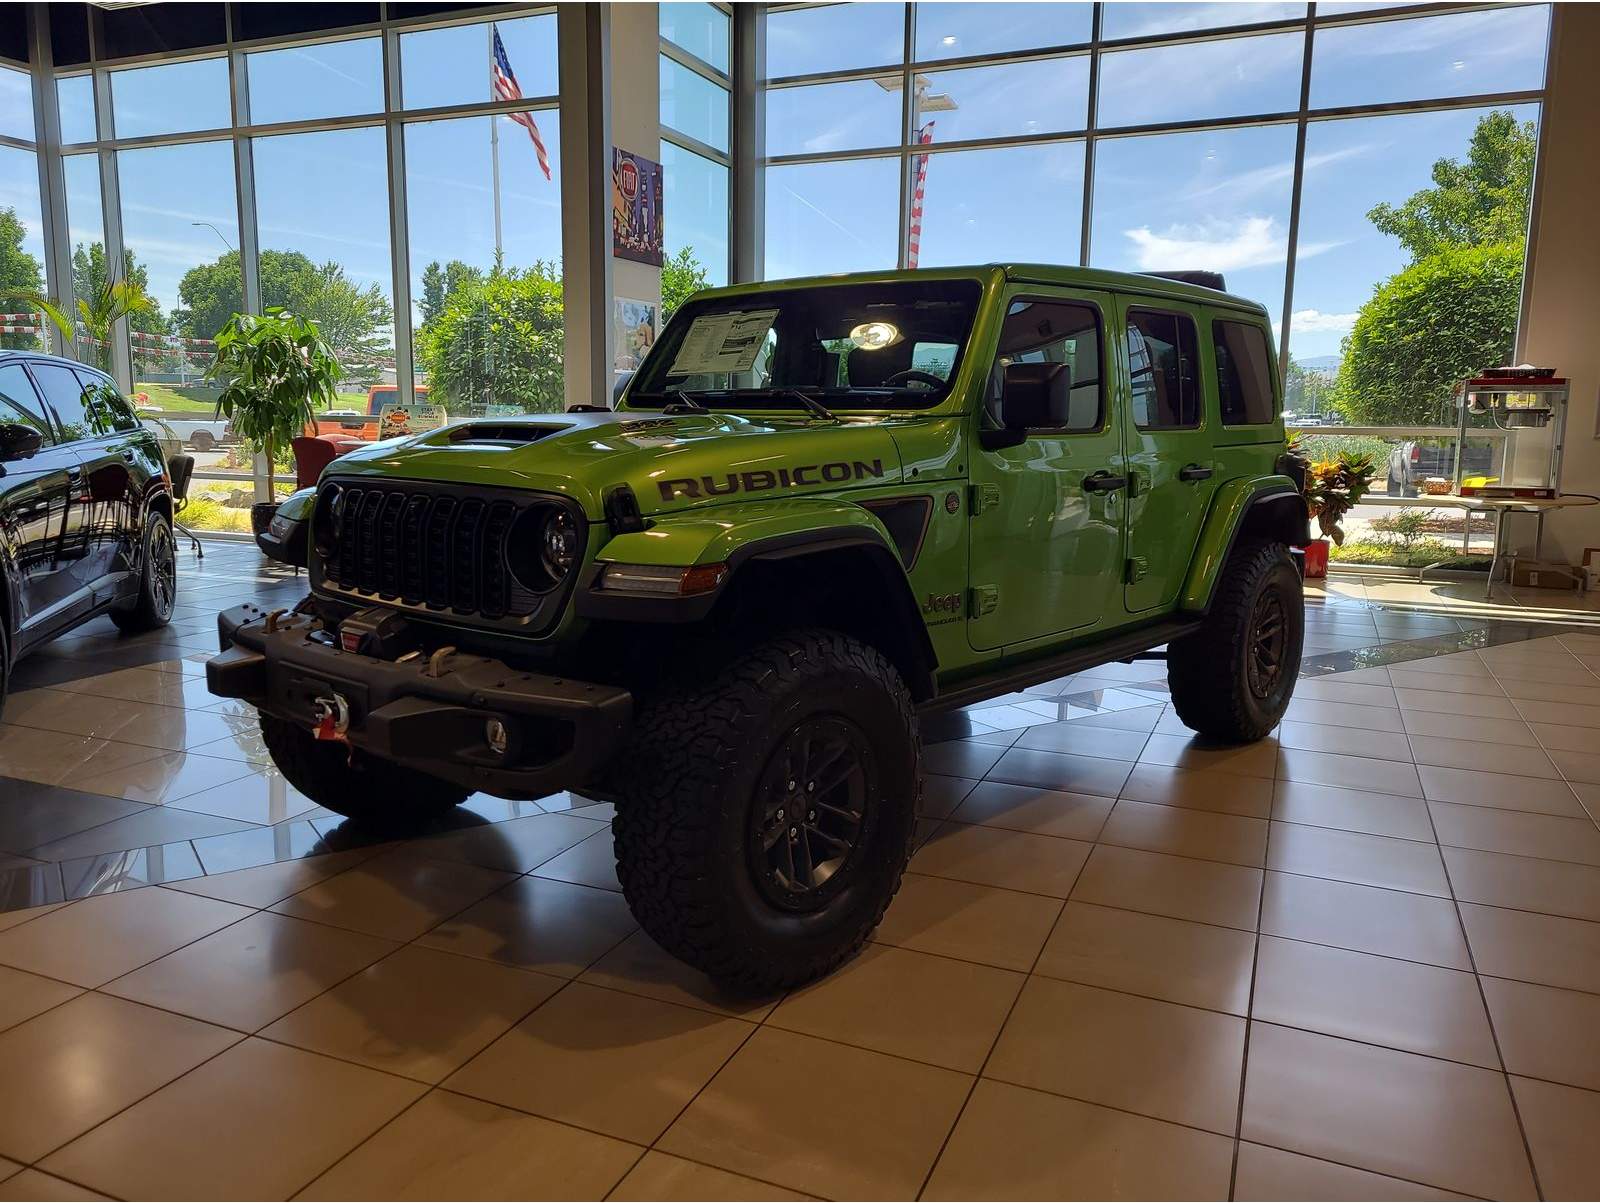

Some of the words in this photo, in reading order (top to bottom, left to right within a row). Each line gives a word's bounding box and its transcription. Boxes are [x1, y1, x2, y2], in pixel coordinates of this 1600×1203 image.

[623, 170, 637, 191] FIAT
[656, 459, 884, 502] RUBICON
[922, 592, 961, 613] Jeep
